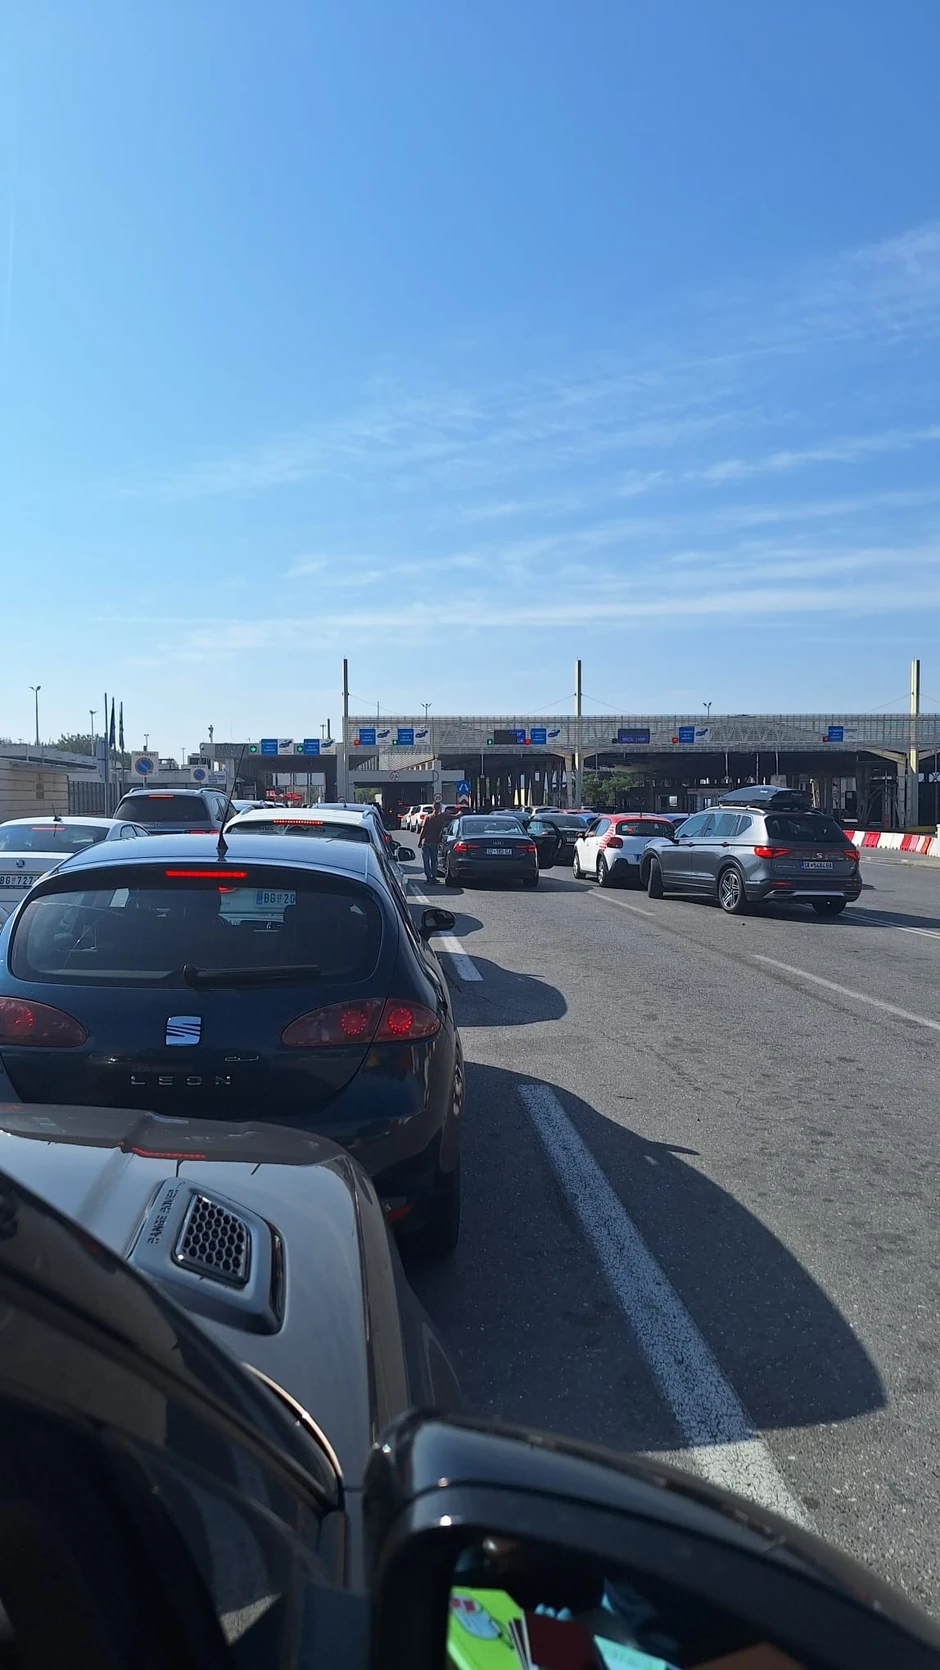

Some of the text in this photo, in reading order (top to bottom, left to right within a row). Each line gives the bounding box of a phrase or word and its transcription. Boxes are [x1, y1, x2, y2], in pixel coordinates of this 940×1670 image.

[263, 893, 276, 904] BG
[130, 1075, 232, 1086] LEON
[148, 1215, 167, 1244] RANGE
